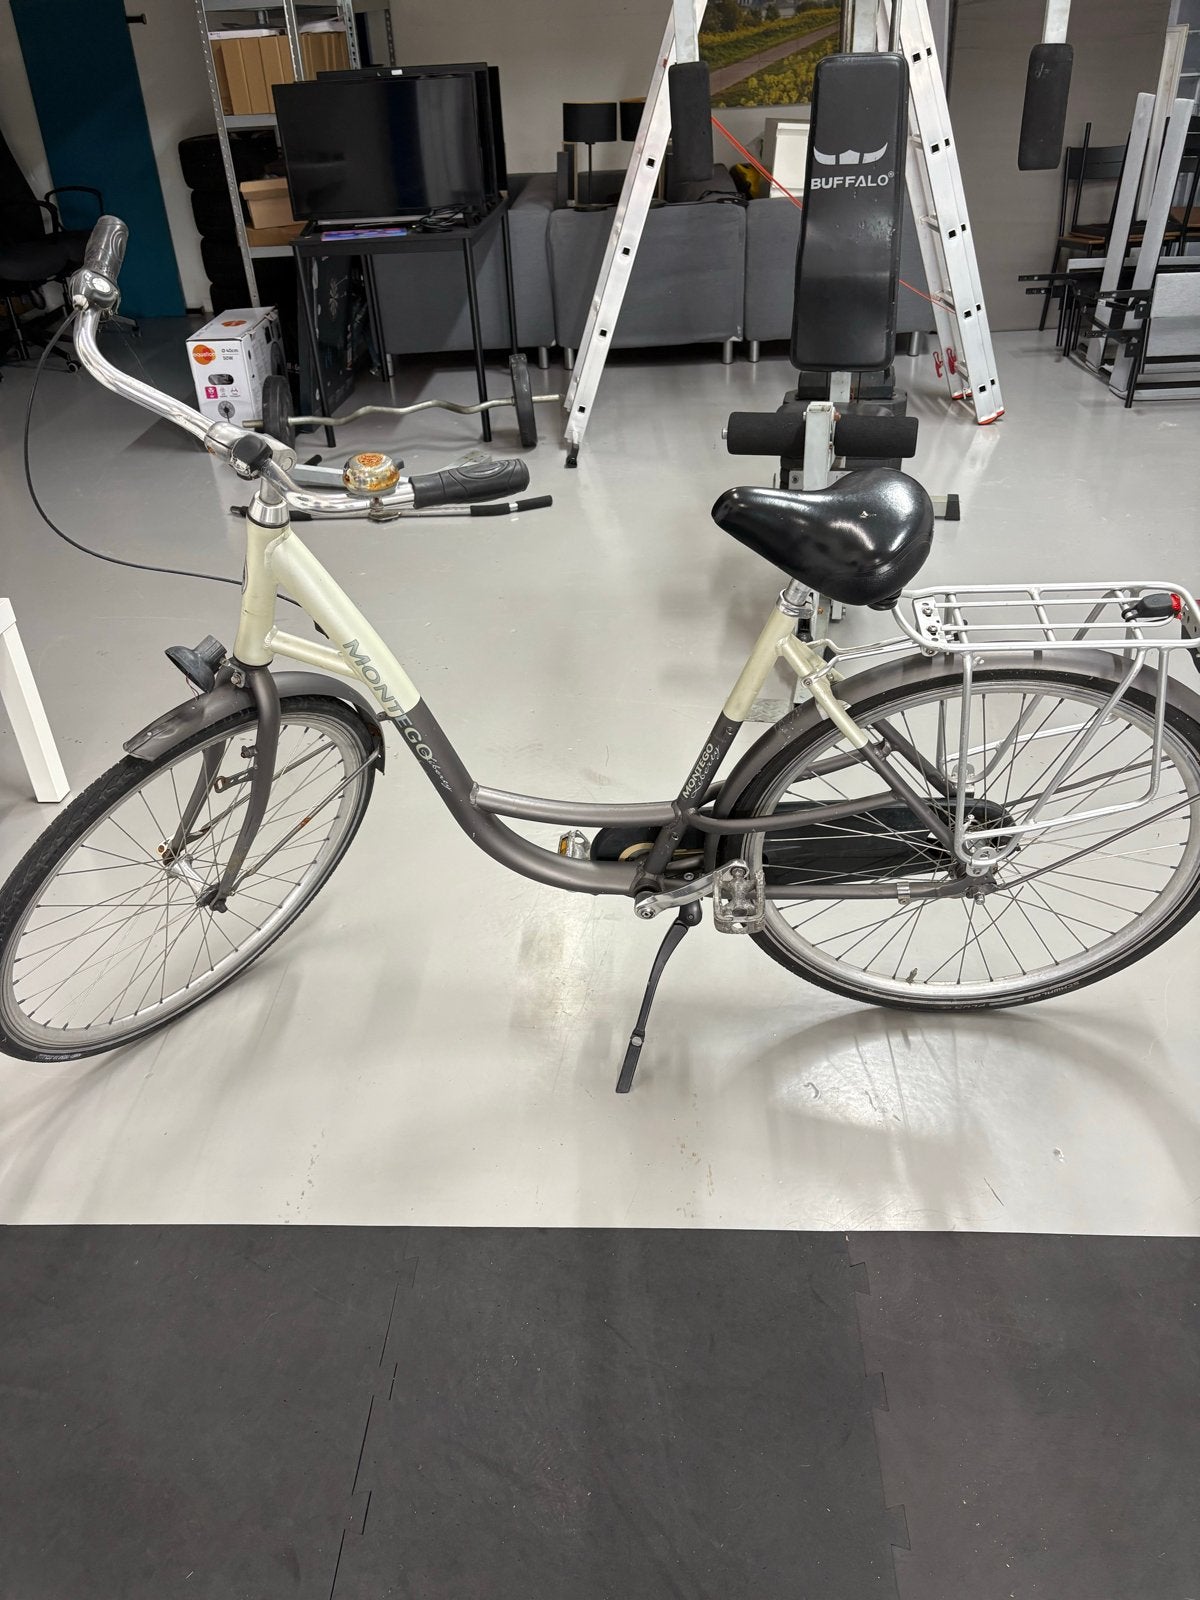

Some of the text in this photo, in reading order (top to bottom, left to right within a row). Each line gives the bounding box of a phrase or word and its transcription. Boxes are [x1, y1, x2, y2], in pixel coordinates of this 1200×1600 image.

[343, 638, 433, 761] MONTEGO
[682, 743, 714, 799] MONTEGO
[691, 745, 720, 799] Liberty
